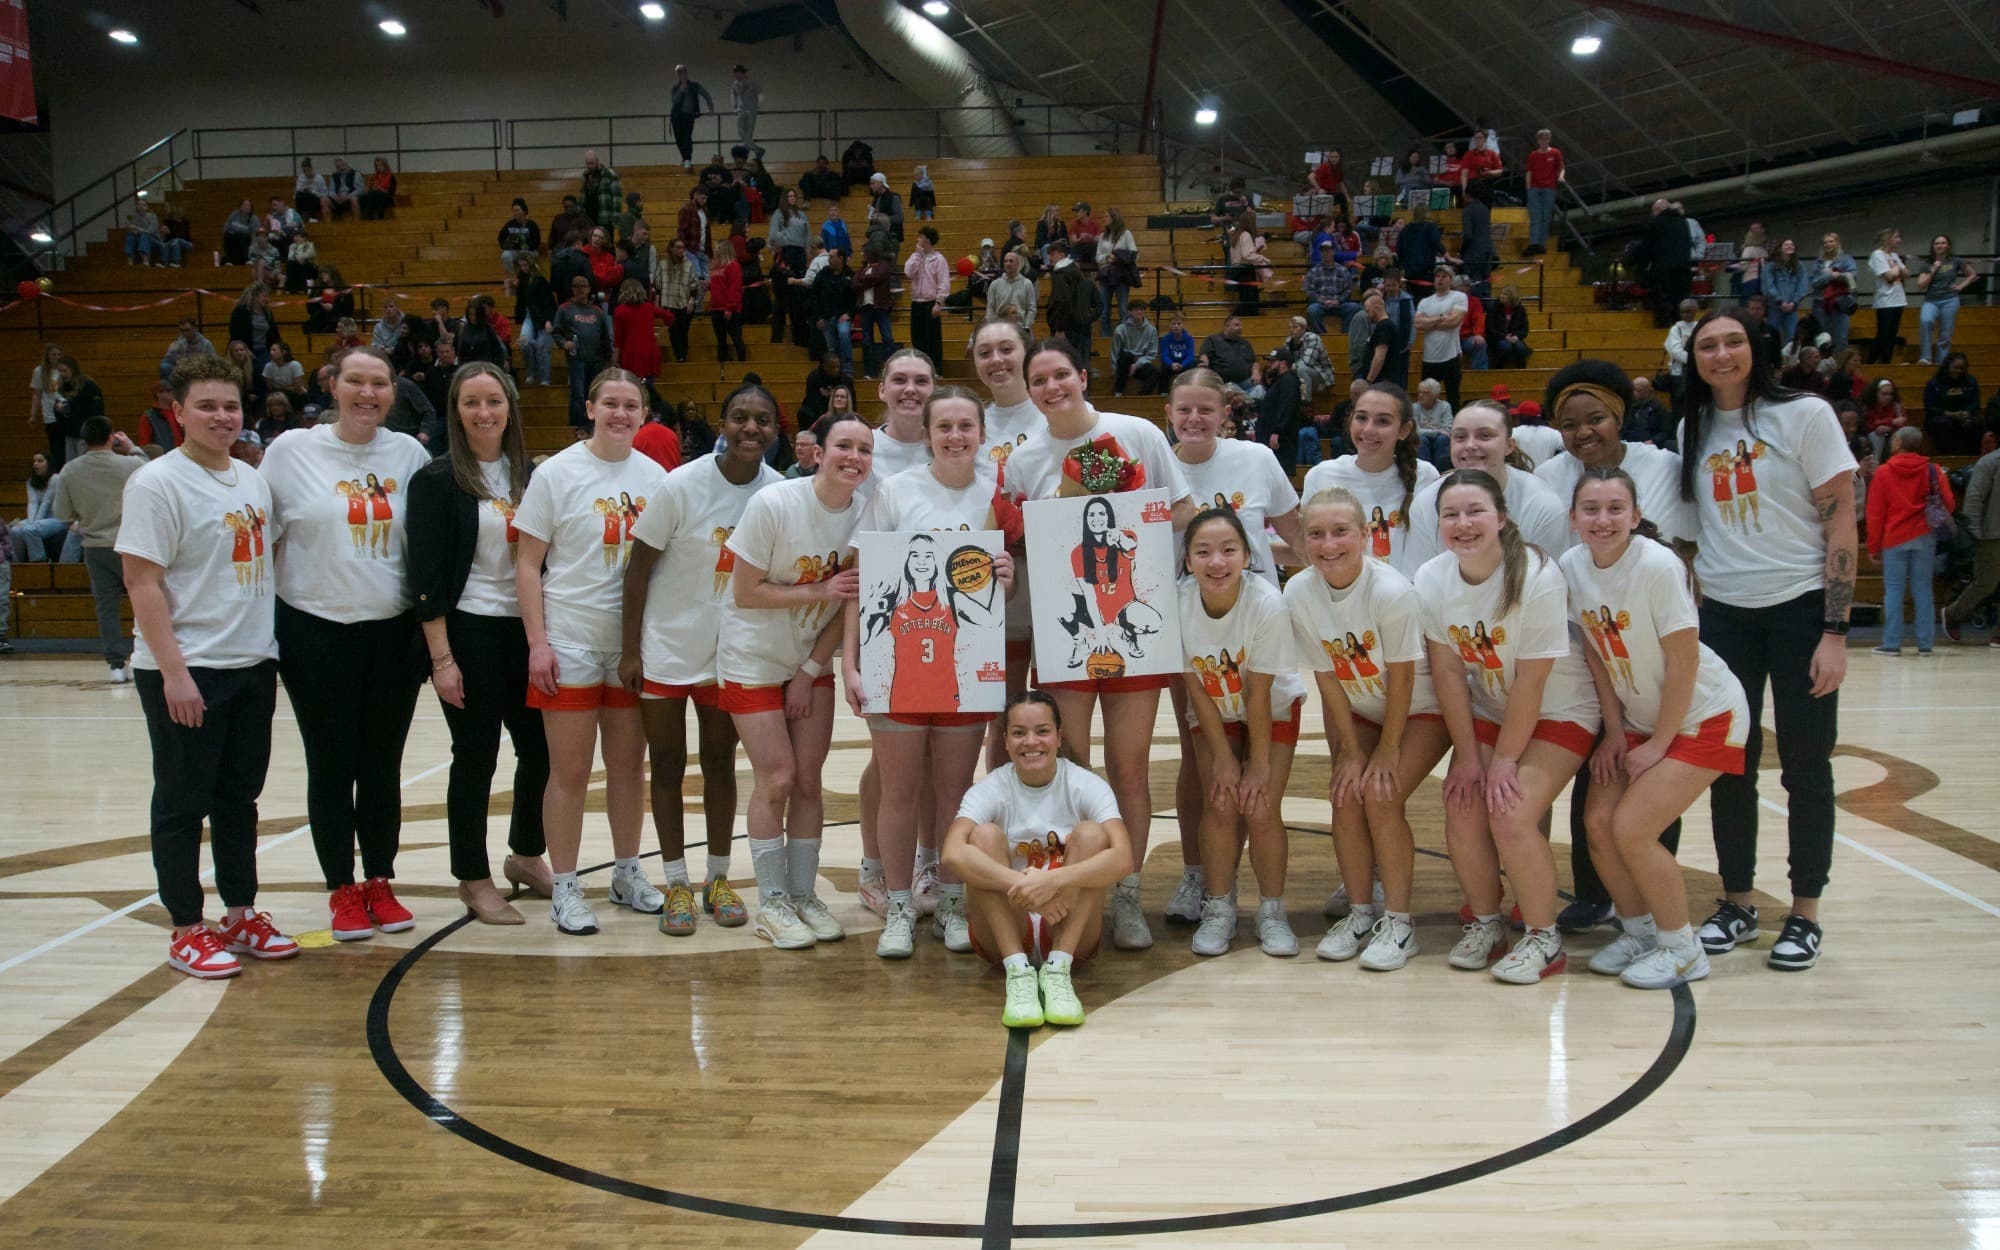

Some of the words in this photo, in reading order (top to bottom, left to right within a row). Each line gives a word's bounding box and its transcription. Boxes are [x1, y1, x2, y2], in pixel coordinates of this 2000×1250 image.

[1144, 500, 1166, 512] #12
[958, 572, 982, 585] NCAA
[921, 638, 935, 664] 3
[983, 661, 999, 671] #3
